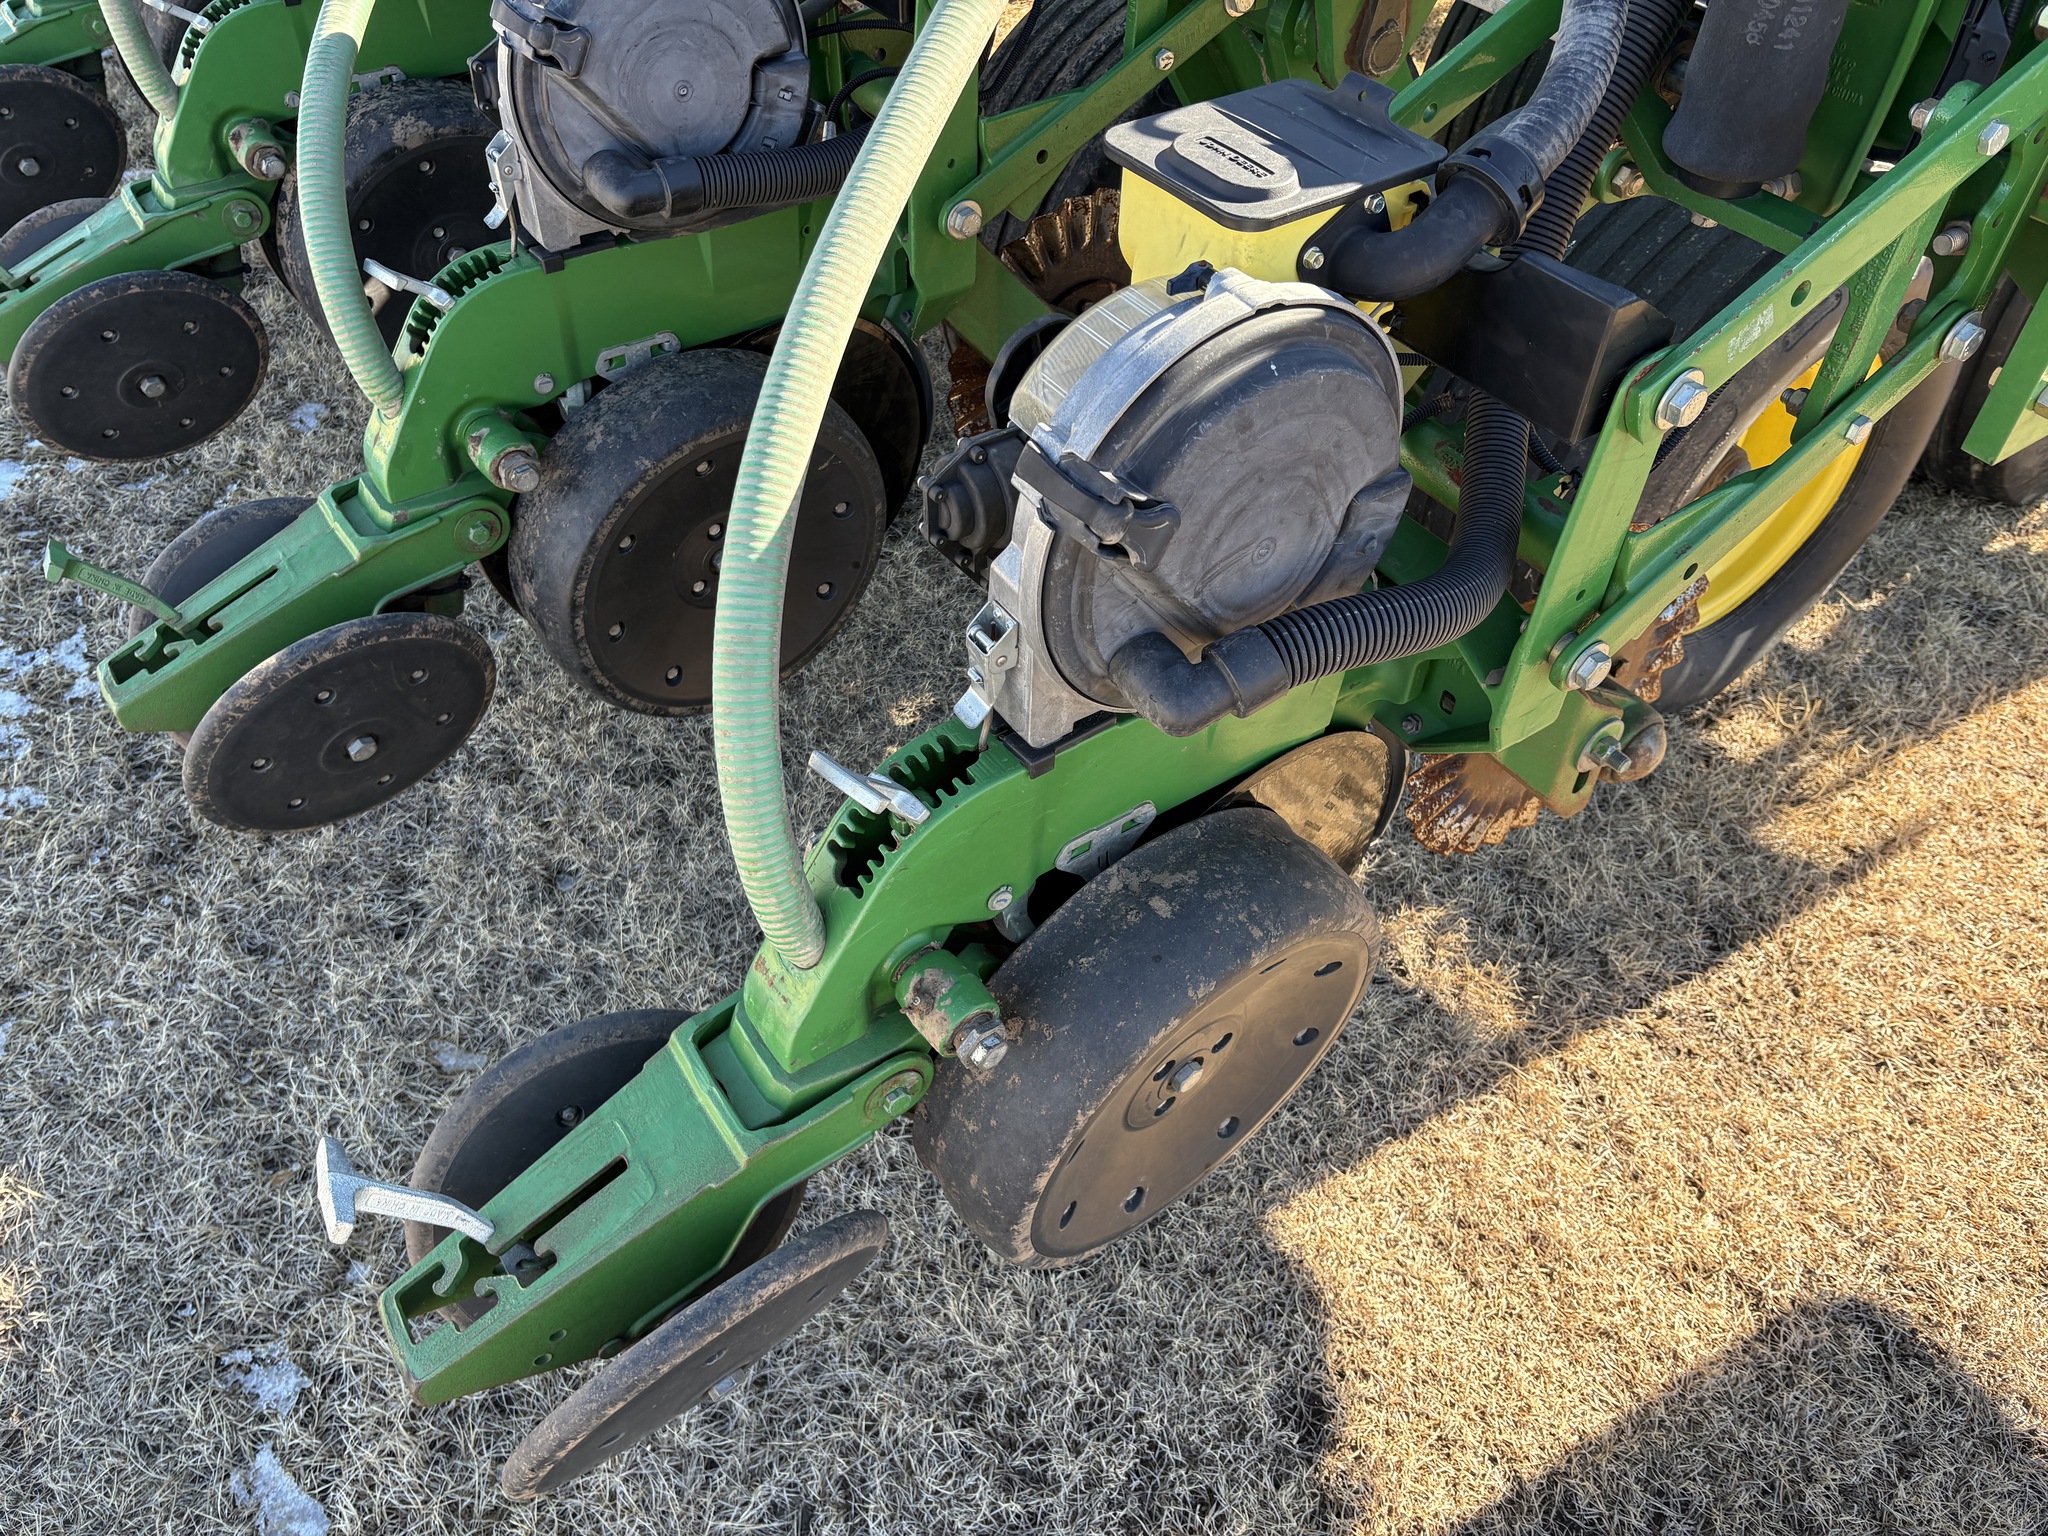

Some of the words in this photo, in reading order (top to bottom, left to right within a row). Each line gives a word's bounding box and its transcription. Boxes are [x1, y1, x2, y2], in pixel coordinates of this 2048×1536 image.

[1199, 141, 1230, 157] JOHN
[1228, 156, 1268, 178] DEERE
[86, 572, 109, 587] CHINA
[112, 582, 121, 592] IN
[125, 587, 146, 602] MADE
[376, 1197, 405, 1211] CHINA
[425, 1207, 452, 1220] MADE
